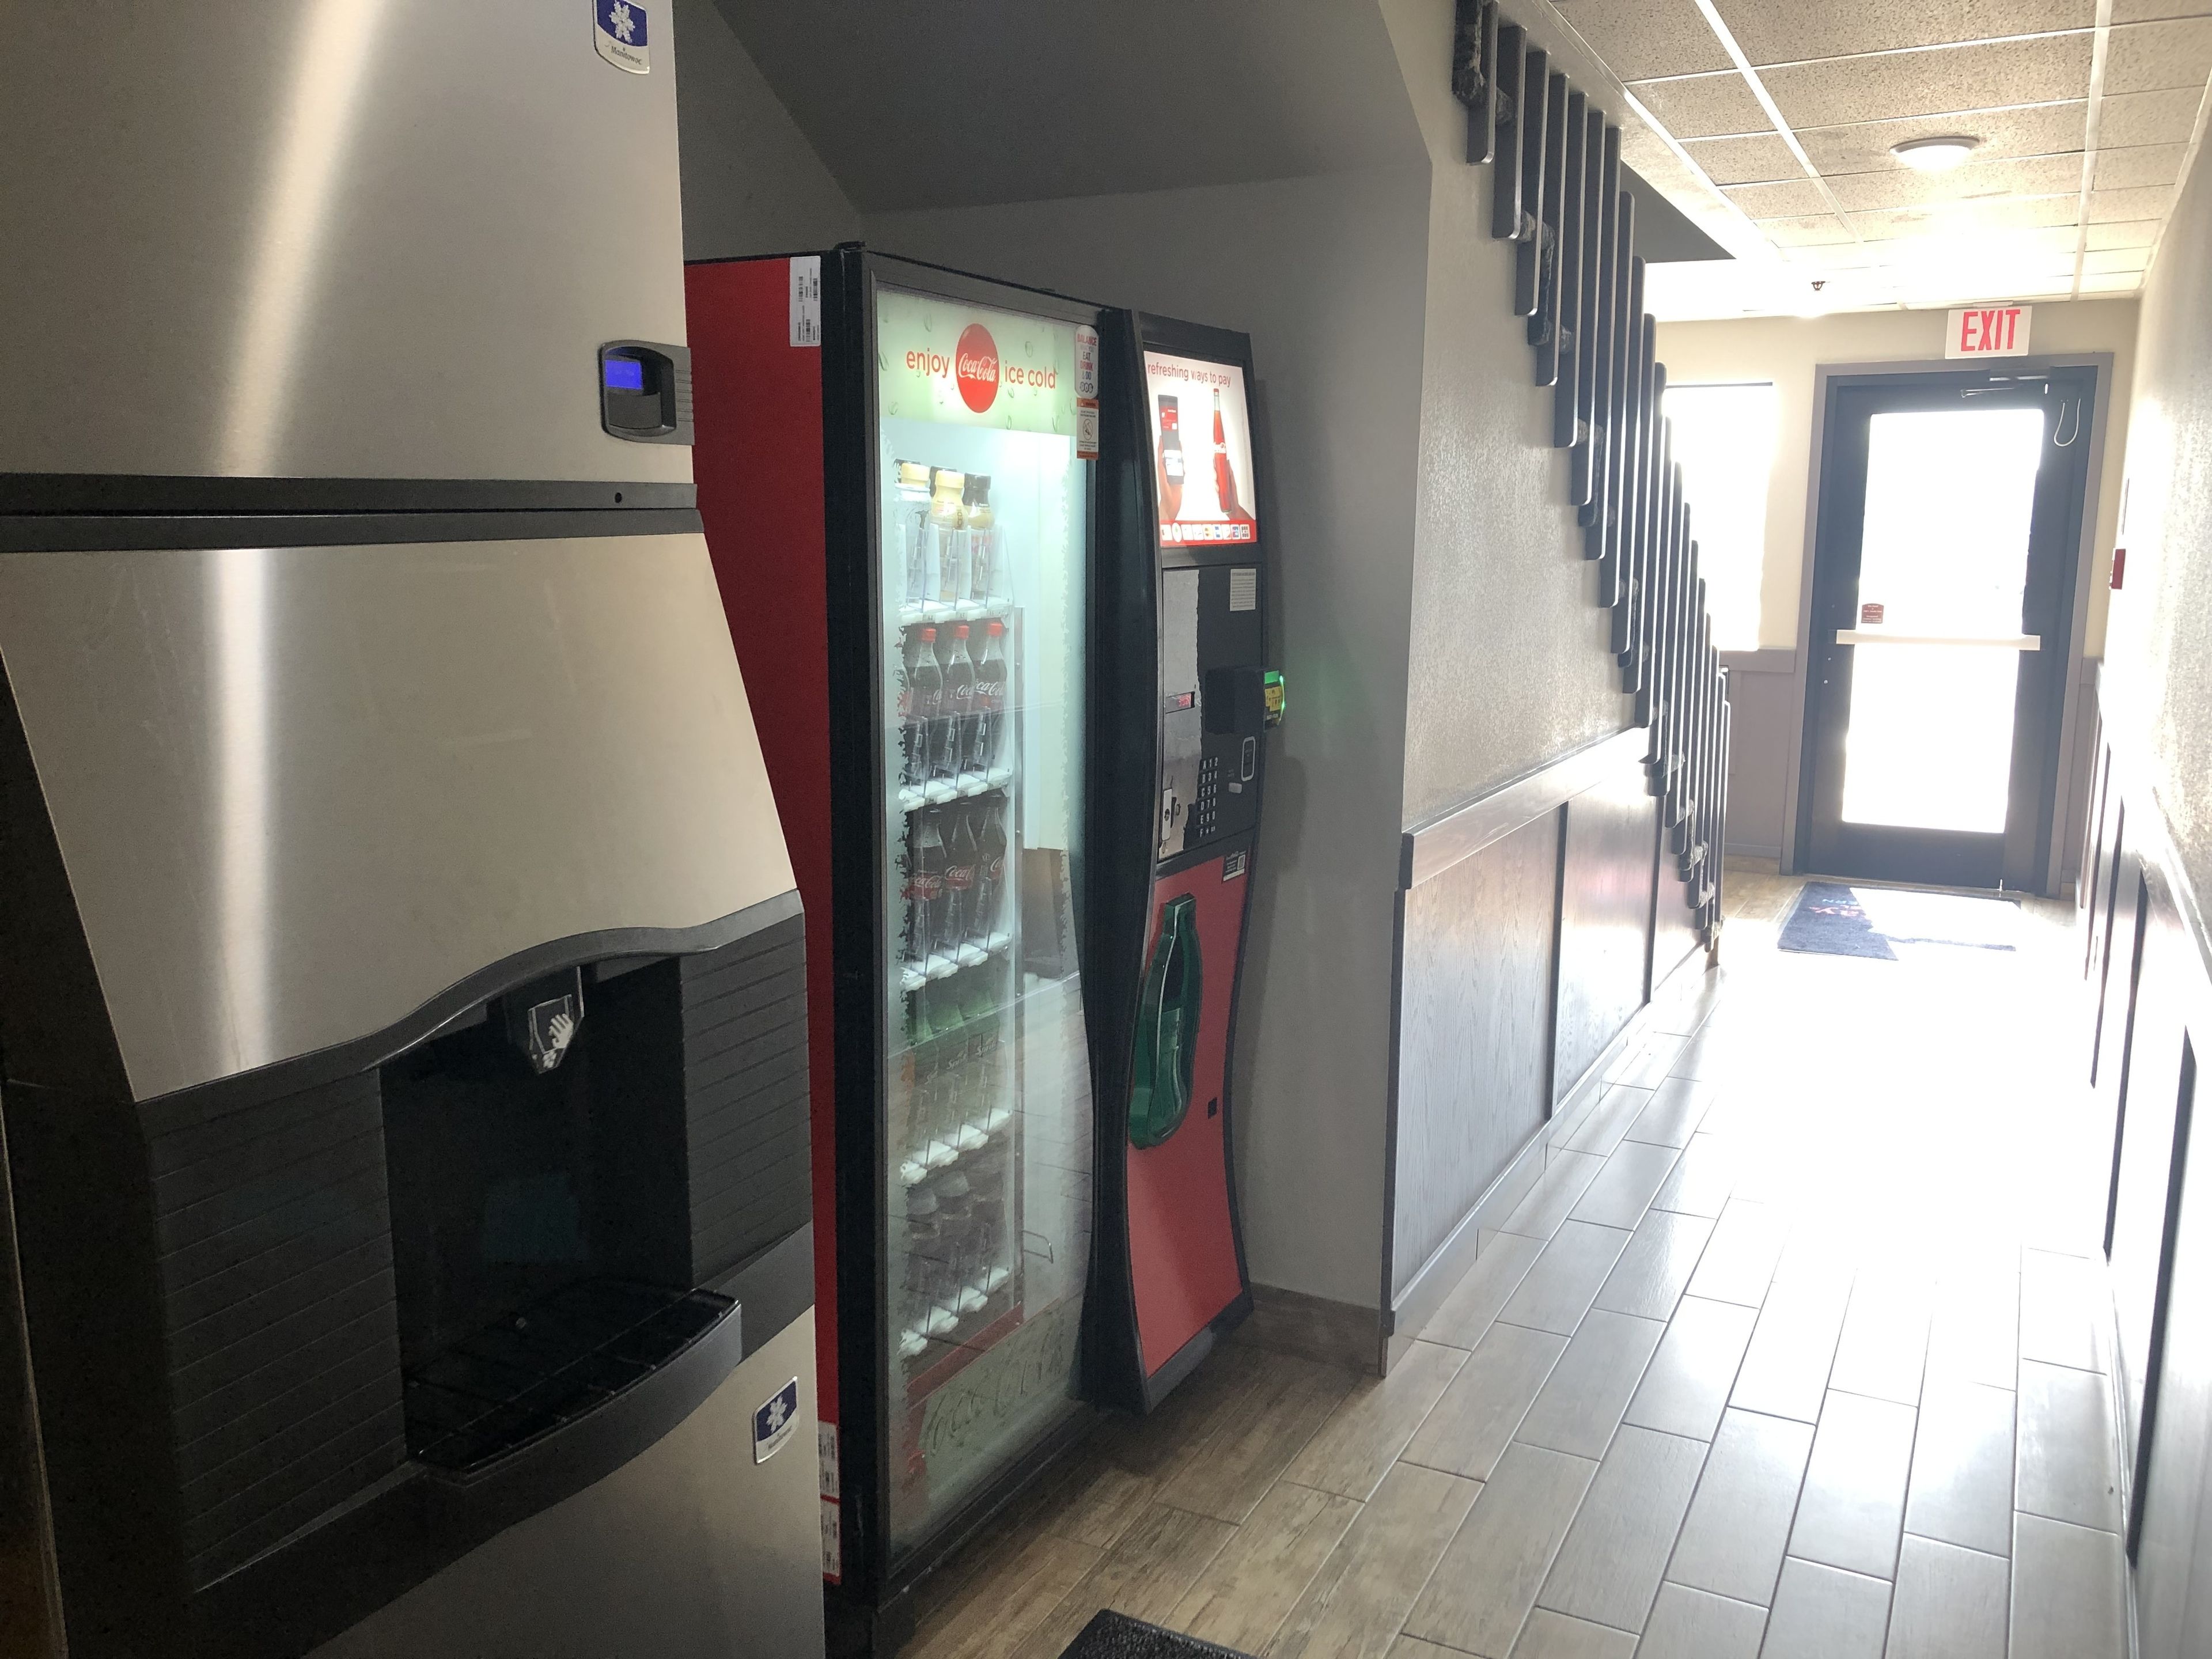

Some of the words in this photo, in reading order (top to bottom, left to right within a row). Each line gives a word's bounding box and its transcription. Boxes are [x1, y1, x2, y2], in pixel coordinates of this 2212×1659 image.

[1961, 309, 2020, 351] EXIT
[1077, 334, 1097, 346] BALANCE
[1082, 351, 1090, 361] EAT
[906, 347, 950, 378] enjoy
[1005, 360, 1024, 384] ice
[1028, 366, 1056, 389] cold
[1080, 360, 1093, 371] DRINK
[1147, 362, 1189, 381] refreshing
[1191, 369, 1209, 384] ways
[1210, 371, 1217, 384] to
[1218, 374, 1231, 388] pay
[1203, 760, 1206, 770] A
[1210, 759, 1212, 767] 1
[1214, 757, 1218, 766] 2
[1202, 774, 1206, 783] B
[1209, 772, 1211, 781] 3
[1214, 771, 1217, 779] 4
[1202, 787, 1205, 797] C
[1207, 786, 1211, 795] 5
[1213, 784, 1217, 793] 6
[1200, 801, 1205, 810] D
[1207, 800, 1210, 808] 7
[1213, 798, 1216, 806] 8
[1200, 815, 1204, 824] E
[1206, 813, 1210, 822] 9
[1212, 811, 1215, 820] 0
[1200, 828, 1203, 838] F
